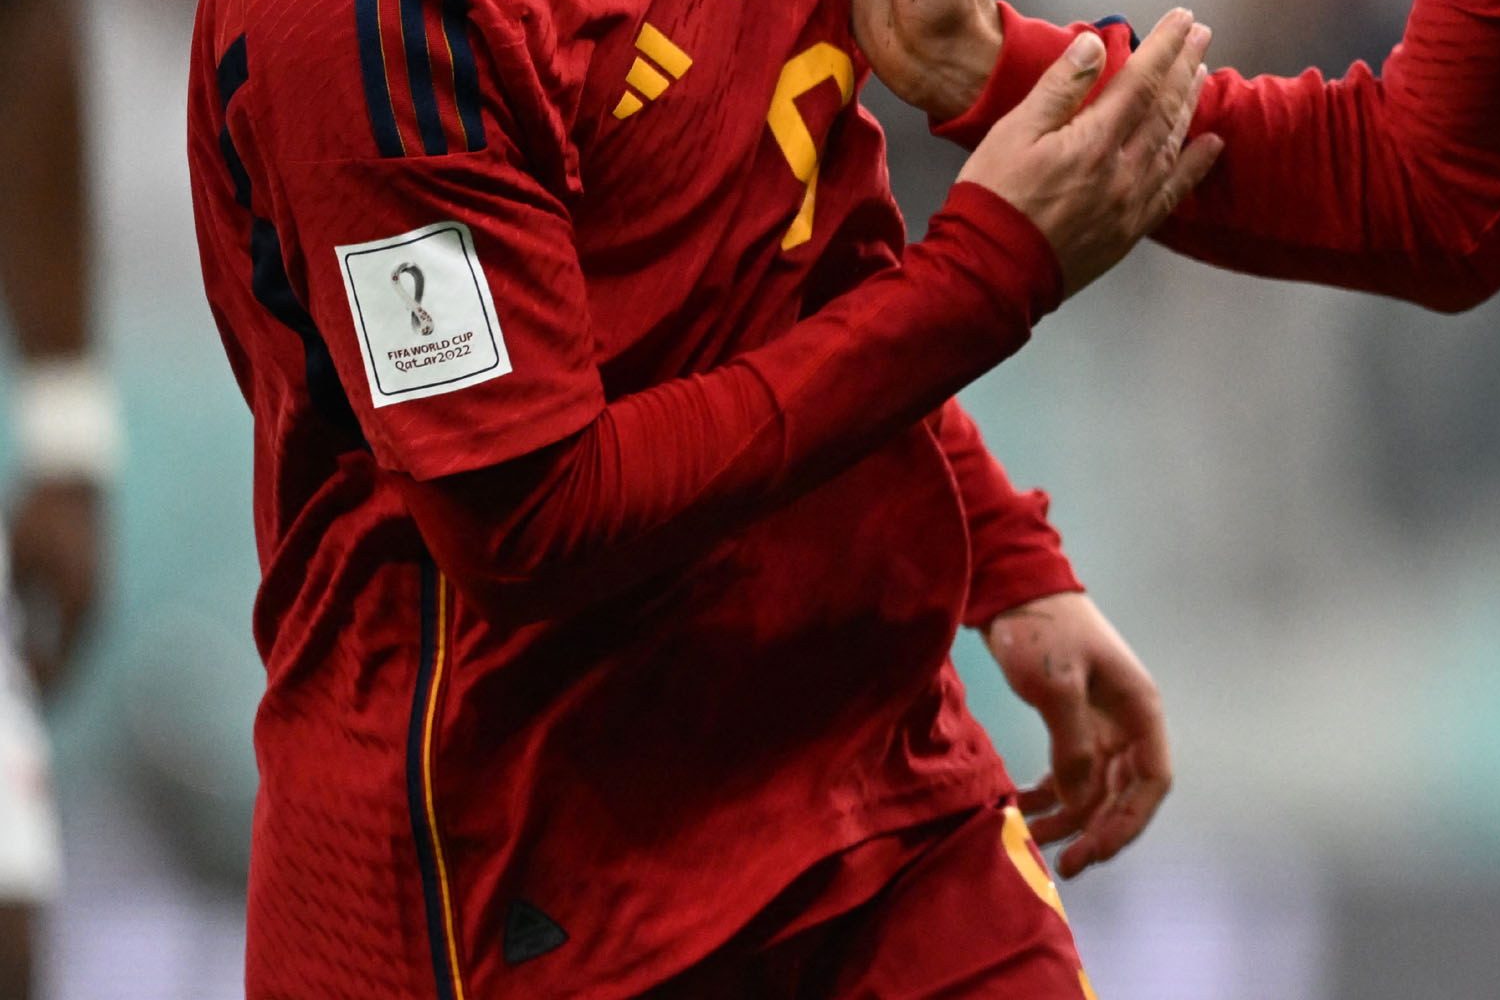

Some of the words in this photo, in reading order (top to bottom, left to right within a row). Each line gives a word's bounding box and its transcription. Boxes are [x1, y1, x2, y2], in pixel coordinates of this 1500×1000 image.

[387, 348, 411, 361] FIFA
[410, 339, 450, 356] WORLD
[452, 331, 474, 346] CUP
